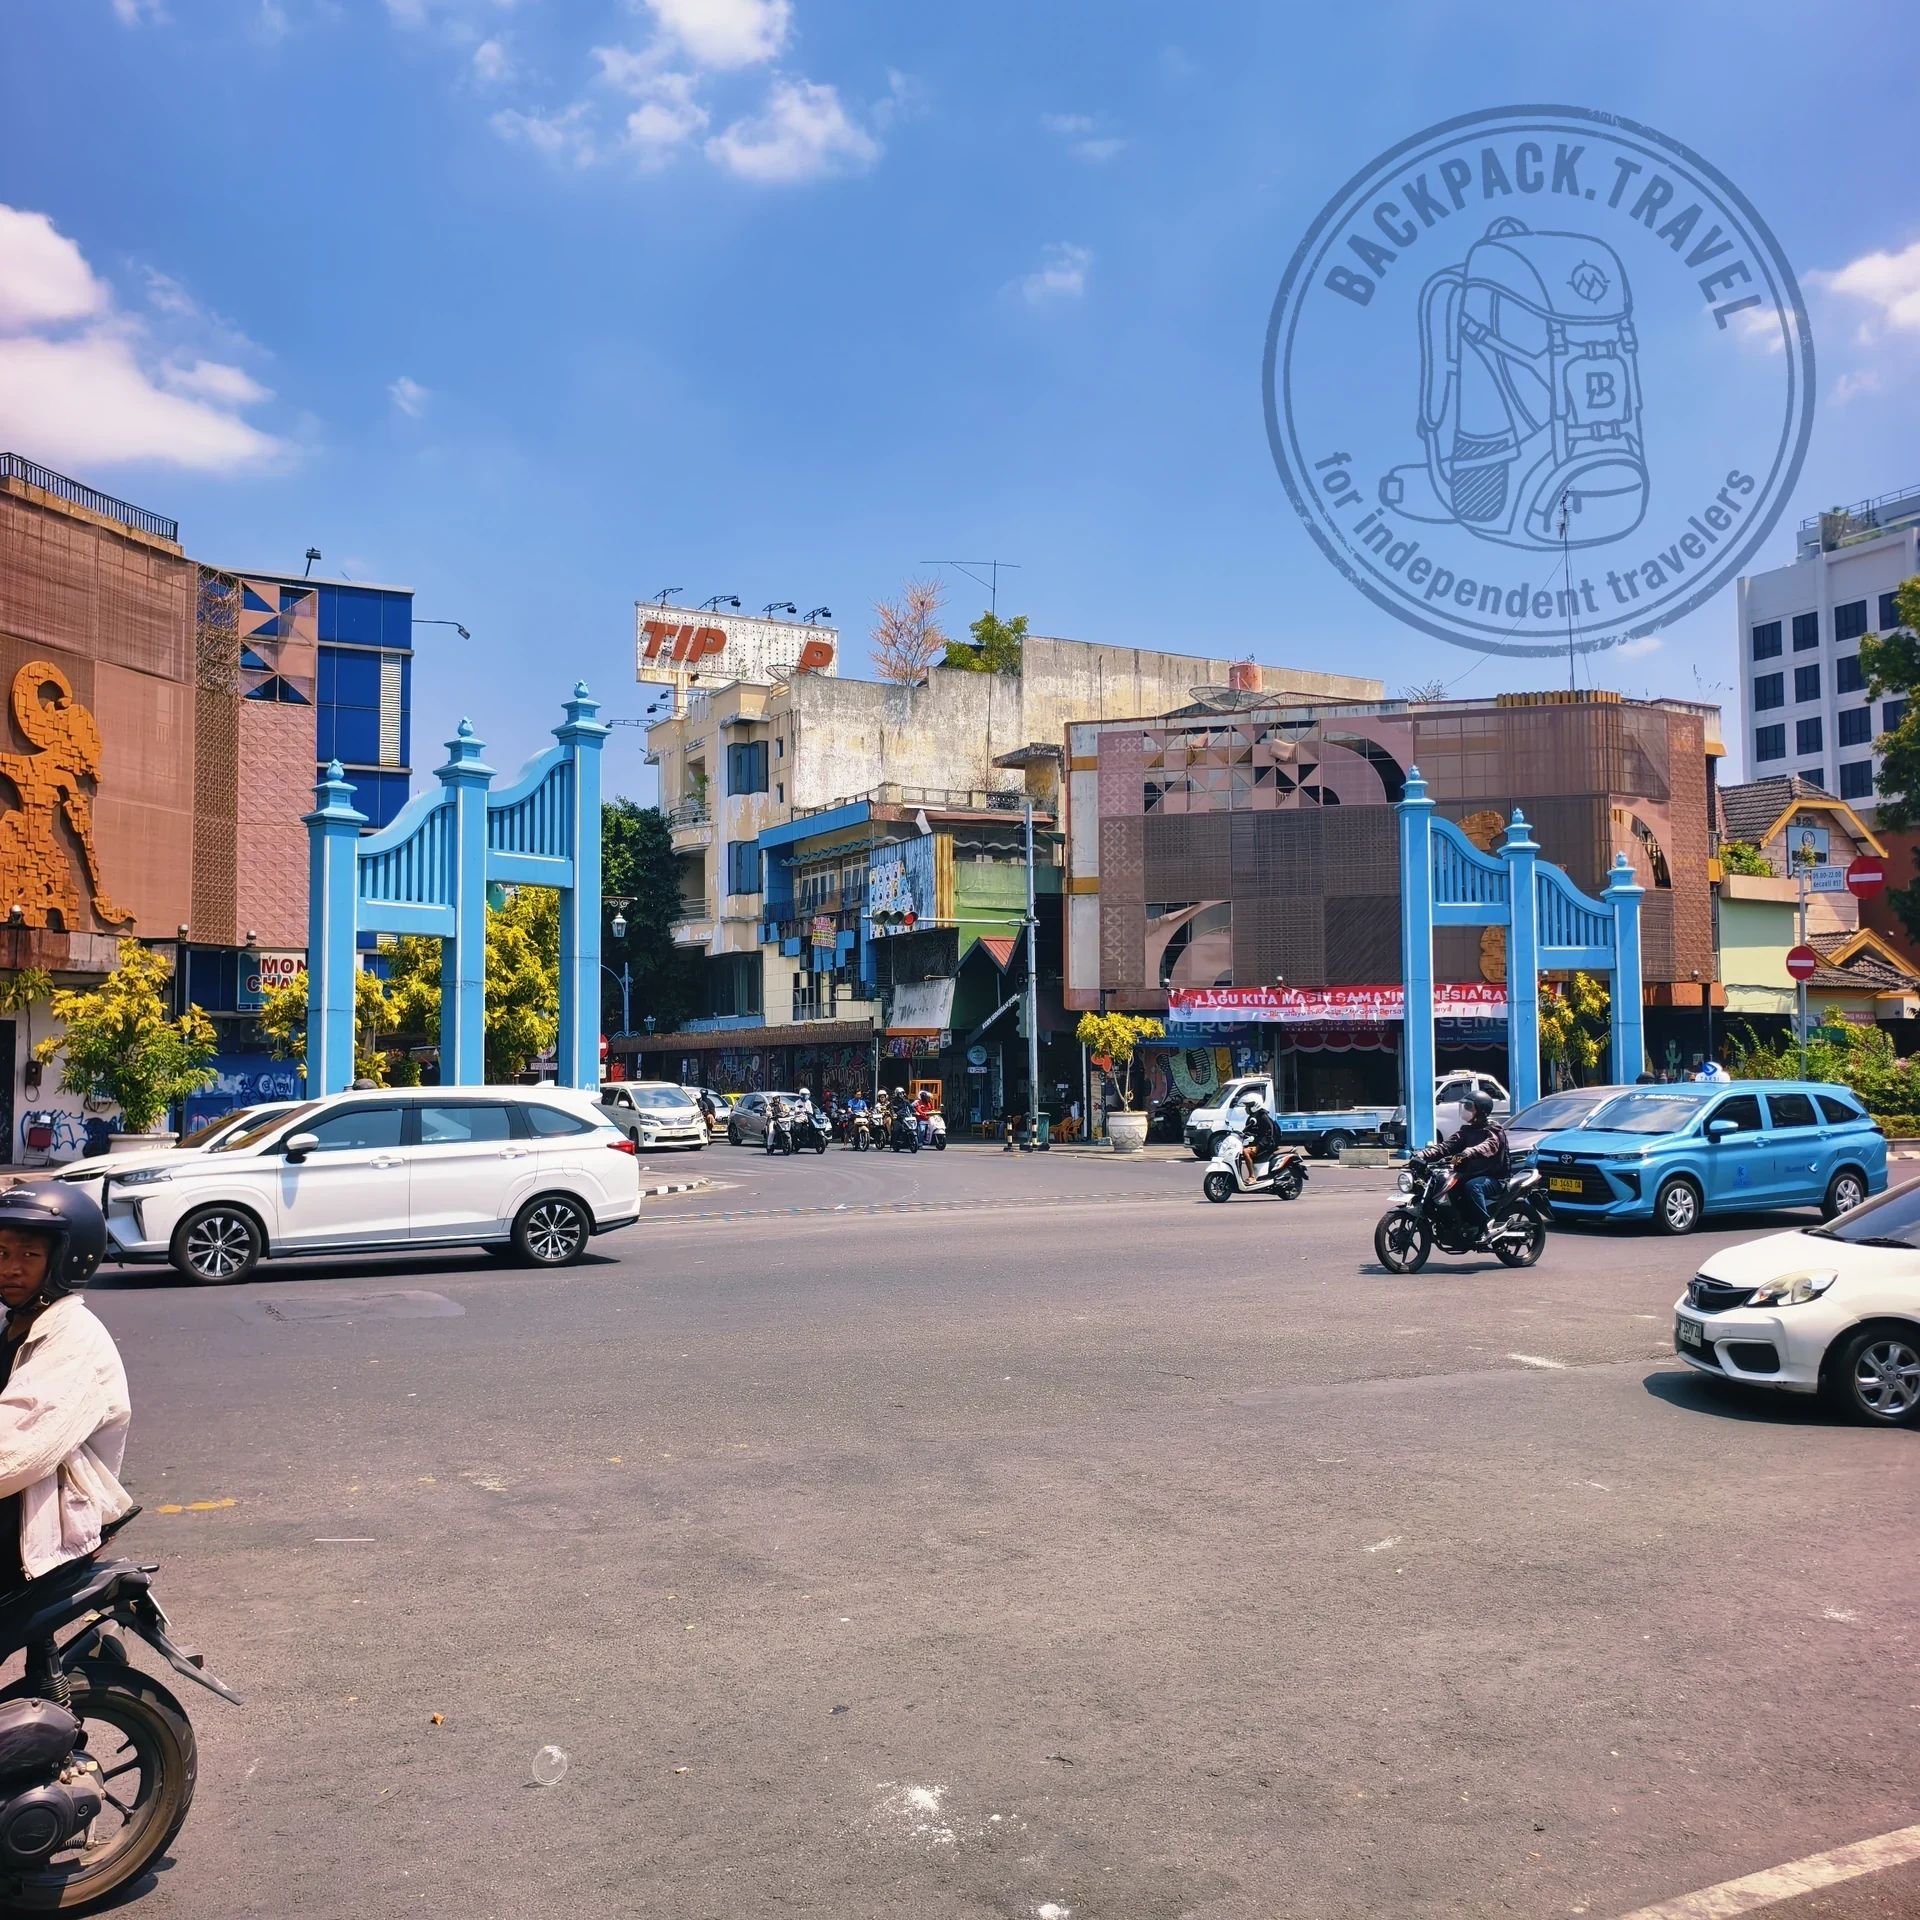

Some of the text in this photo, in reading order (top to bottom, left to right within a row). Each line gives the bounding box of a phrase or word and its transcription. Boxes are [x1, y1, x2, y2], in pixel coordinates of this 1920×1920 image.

[643, 620, 727, 663] TIP
[1196, 993, 1239, 1005] LAGU
[1240, 993, 1279, 1005] KITA
